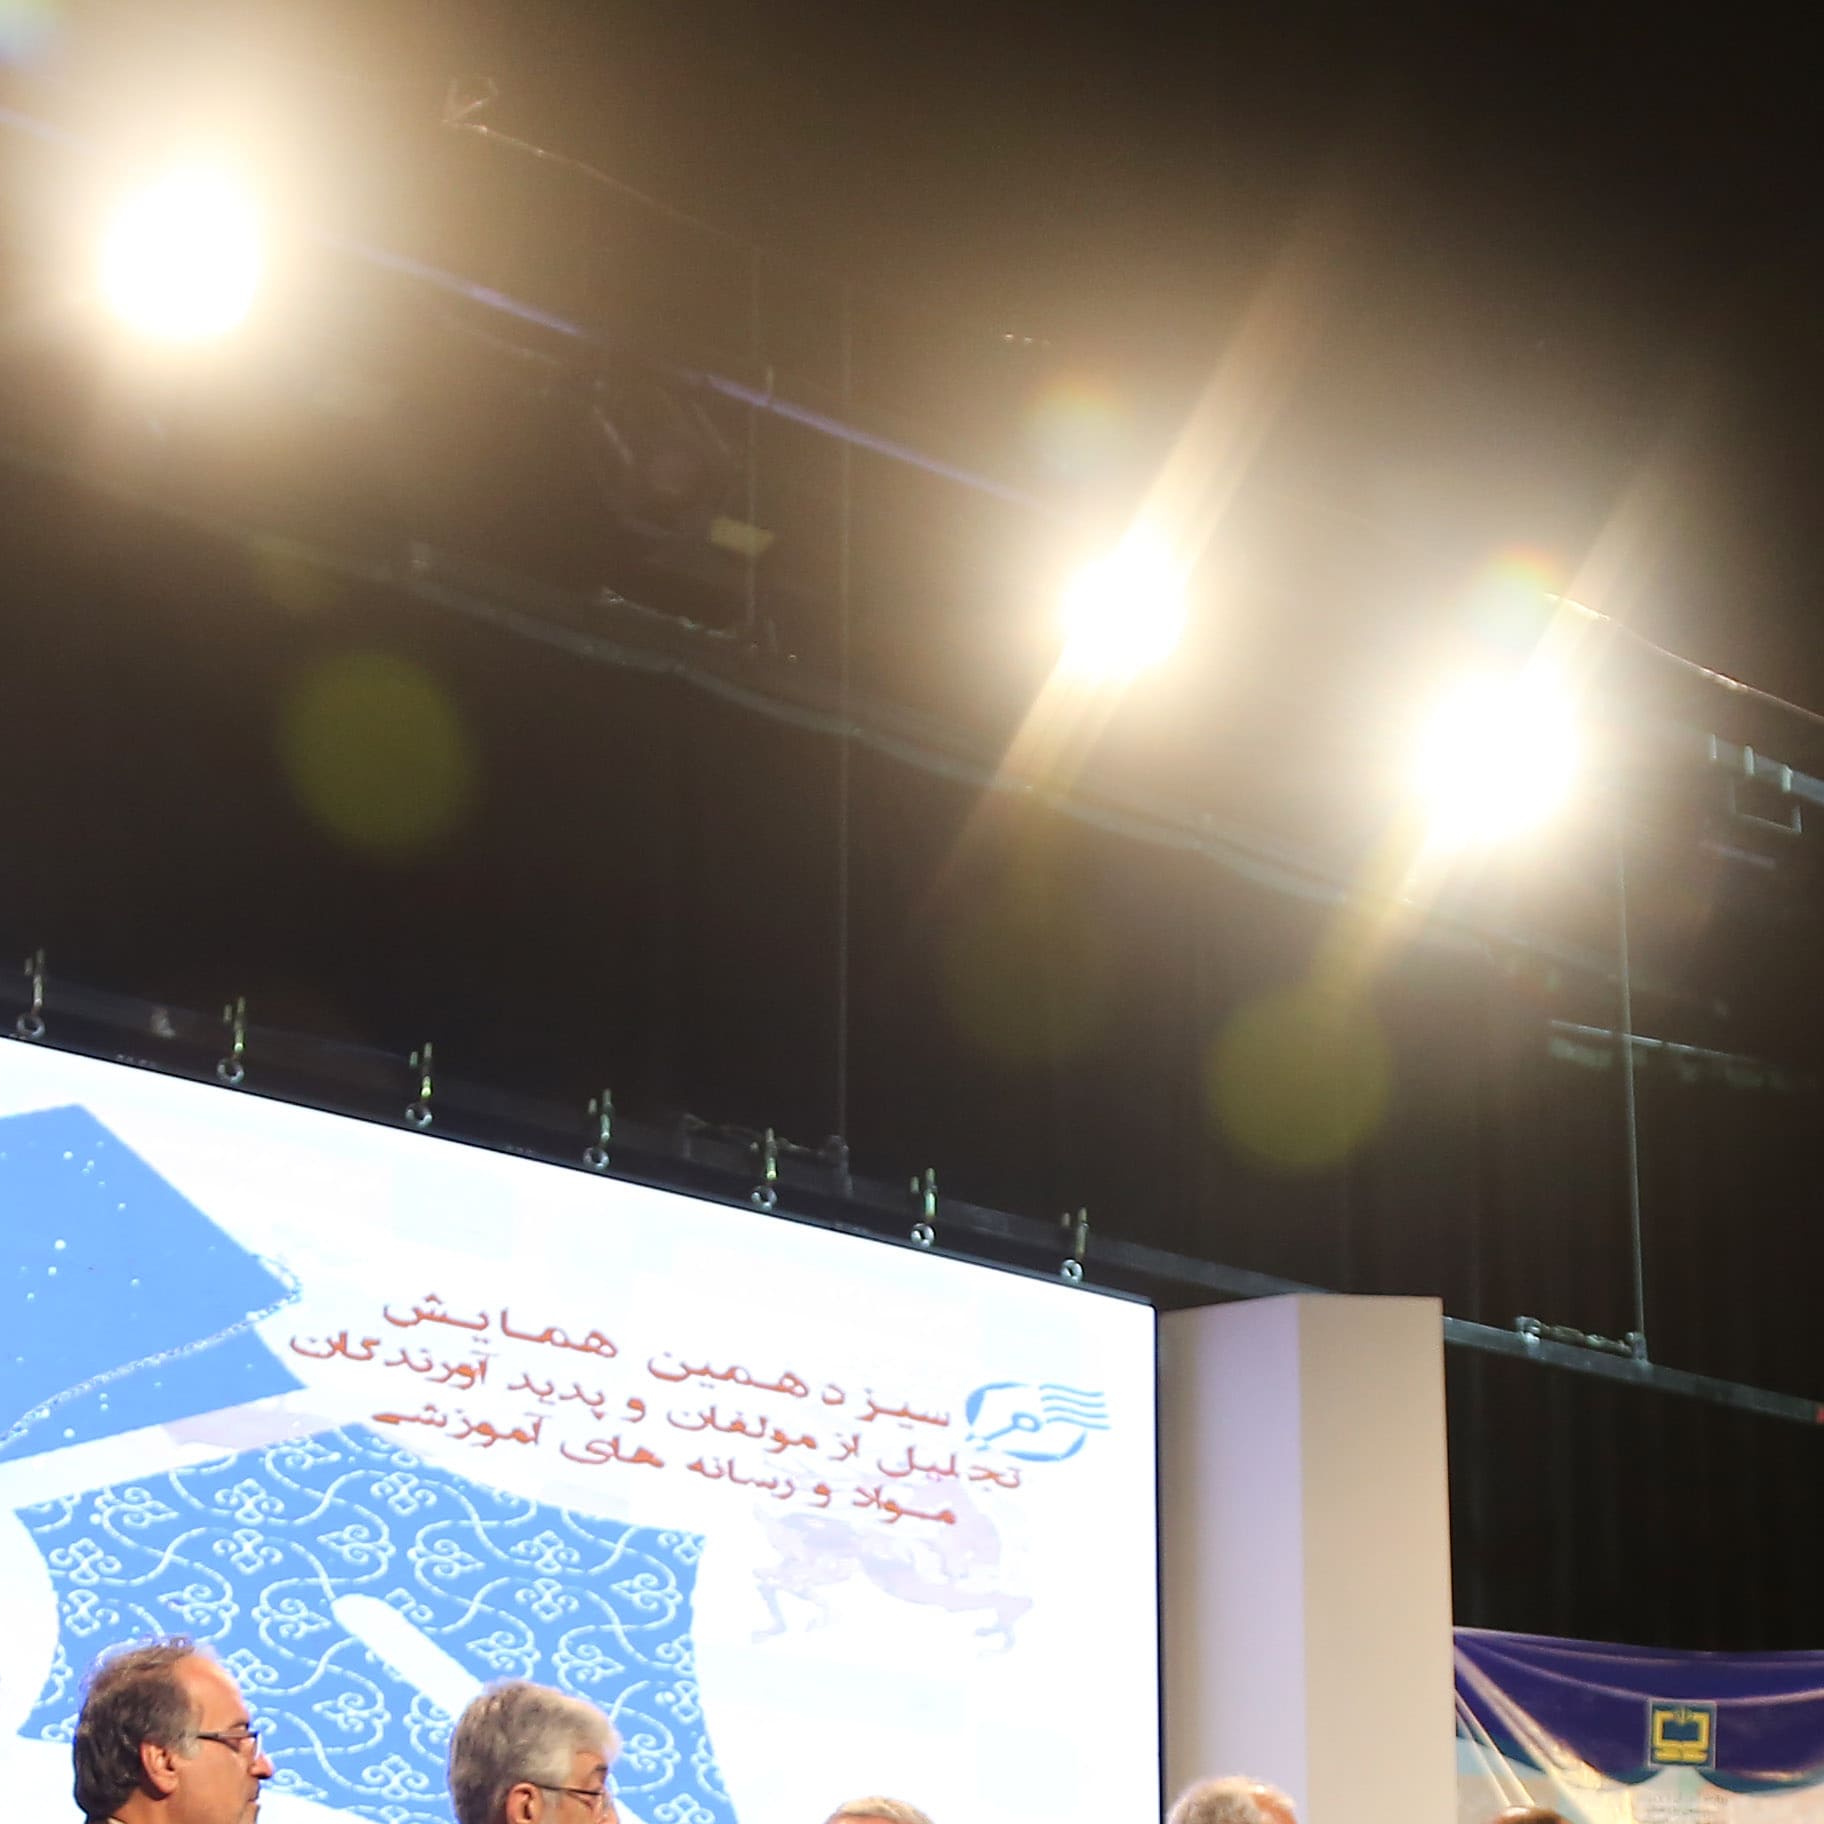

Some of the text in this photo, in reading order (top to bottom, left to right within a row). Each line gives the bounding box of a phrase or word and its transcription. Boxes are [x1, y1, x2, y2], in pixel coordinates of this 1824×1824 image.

[382, 1293, 619, 1359] همایش
[506, 1372, 606, 1421] پدید
[618, 1396, 647, 1424] و
[666, 1405, 818, 1454] مولفان
[827, 1431, 861, 1461] از
[559, 1436, 666, 1469] های
[875, 1446, 1022, 1493] تجلیل
[686, 1457, 796, 1500] رسانه
[807, 1481, 832, 1509] و
[851, 1485, 957, 1525] مواد
